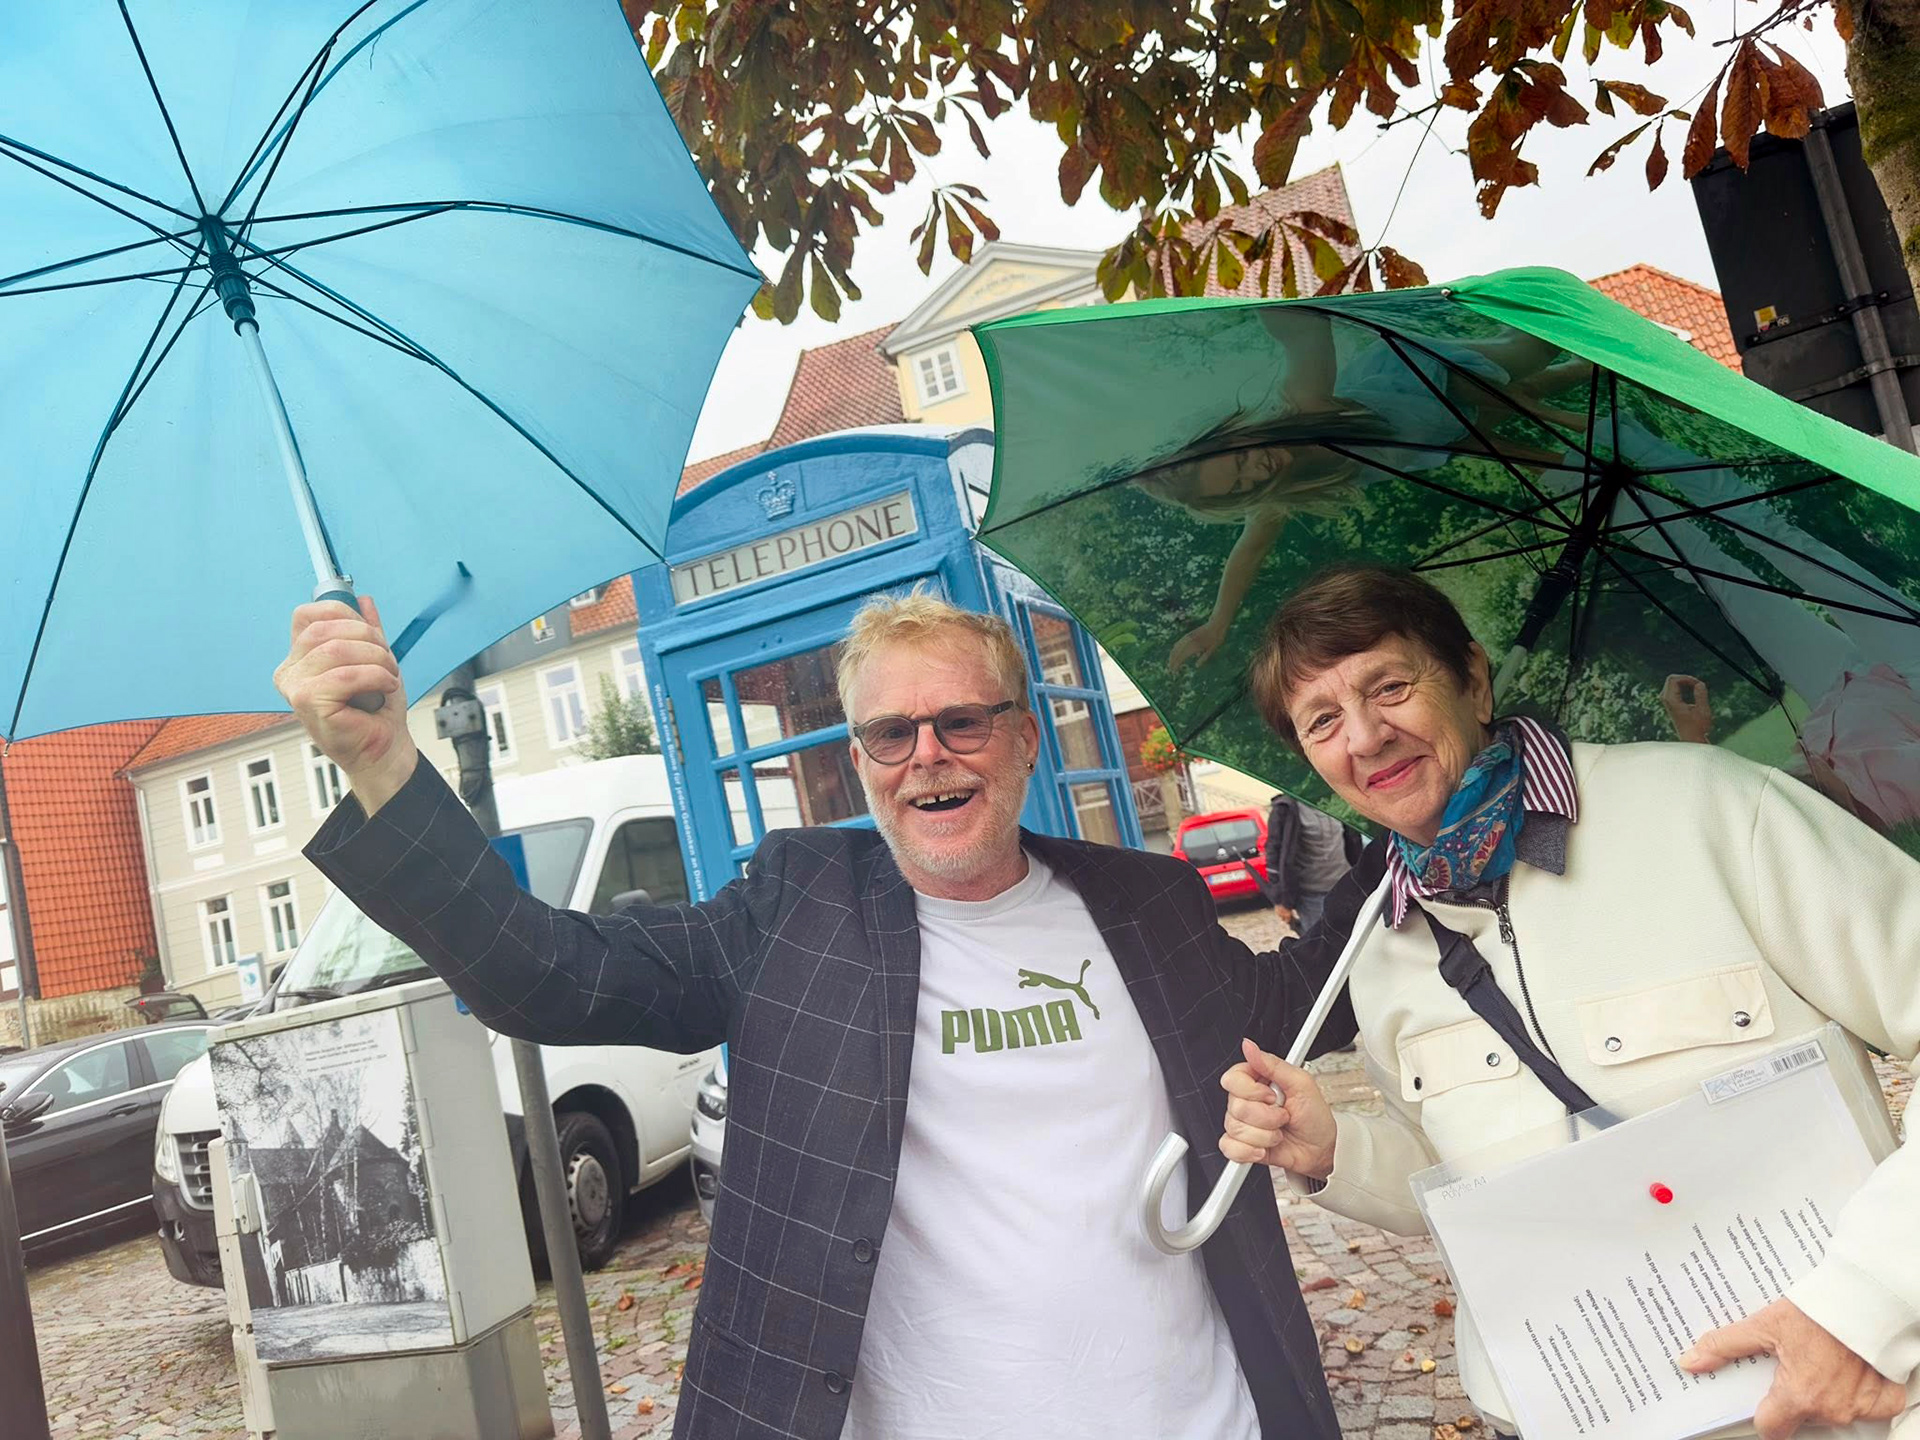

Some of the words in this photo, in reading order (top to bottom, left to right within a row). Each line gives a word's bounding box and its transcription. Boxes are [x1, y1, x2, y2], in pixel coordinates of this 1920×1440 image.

[682, 502, 906, 596] TELEPHONE
[681, 812, 695, 855] Gedanken
[690, 857, 698, 868] an
[941, 999, 1082, 1054] PUMA
[1779, 1208, 1799, 1238] lordliest
[1820, 1223, 1832, 1238] and
[1742, 1227, 1758, 1251] cycles
[1806, 1226, 1816, 1239] the
[1761, 1234, 1783, 1267] moulded
[1797, 1238, 1807, 1251] the
[1690, 1250, 1699, 1263] tail
[1701, 1240, 1721, 1271] sapphire
[1737, 1249, 1752, 1271] world
[1755, 1251, 1765, 1265] five
[1648, 1261, 1658, 1273] did
[1680, 1262, 1690, 1276] veil
[1697, 1263, 1704, 1271] to
[1781, 1266, 1791, 1280] she
[1655, 1273, 1663, 1283] he
[1688, 1275, 1698, 1288] the
[1701, 1271, 1715, 1290] head
[1717, 1271, 1725, 1280] of
[1750, 1271, 1760, 1283] the
[1763, 1264, 1782, 1294] through
[1660, 1283, 1675, 1306] where
[1695, 1288, 1706, 1304] rent
[1723, 1280, 1739, 1303] plates
[1757, 1283, 1769, 1299] first
[1585, 1288, 1599, 1310] shade
[1636, 1296, 1648, 1313] urge
[1646, 1286, 1668, 1322] dragon-fly
[1712, 1290, 1725, 1308] from
[1672, 1306, 1686, 1325] wells
[1722, 1308, 1734, 1324] usk:
[1736, 1303, 1747, 1318] lear
[1523, 1318, 1533, 1333] me,
[1584, 1317, 1597, 1336] voice
[1596, 1310, 1614, 1338] endless
[1644, 1313, 1654, 1325] did
[1651, 1325, 1664, 1345] voice
[1665, 1322, 1675, 1335] the
[1683, 1326, 1693, 1338] the
[1530, 1333, 1541, 1349] unto
[1565, 1340, 1572, 1348] to
[1593, 1336, 1607, 1357] small
[1611, 1338, 1618, 1347] in
[1617, 1321, 1643, 1363] wonderfully
[1672, 1335, 1683, 1350] saw
[1569, 1348, 1579, 1361] not
[1615, 1346, 1627, 1363] cast
[1662, 1345, 1671, 1358] the
[1539, 1350, 1553, 1372] spake
[1560, 1362, 1568, 1370] of
[1604, 1357, 1615, 1371] still
[1639, 1363, 1647, 1373] so
[1564, 1370, 1574, 1383] full
[1576, 1362, 1590, 1384] better
[1623, 1363, 1633, 1376] not
[1645, 1373, 1651, 1381] is
[1668, 1358, 1683, 1381] which
[1550, 1372, 1563, 1392] voice
[1612, 1372, 1622, 1385] the
[1630, 1376, 1640, 1389] me
[1681, 1381, 1688, 1390] To
[1572, 1383, 1580, 1393] so
[1587, 1384, 1597, 1397] not
[1619, 1385, 1626, 1393] to
[1648, 1381, 1662, 1401] What
[1560, 1392, 1574, 1413] small
[1577, 1394, 1586, 1404] art
[1623, 1393, 1636, 1412] Then
[1570, 1413, 1581, 1427] still
[1598, 1403, 1610, 1423] Were
